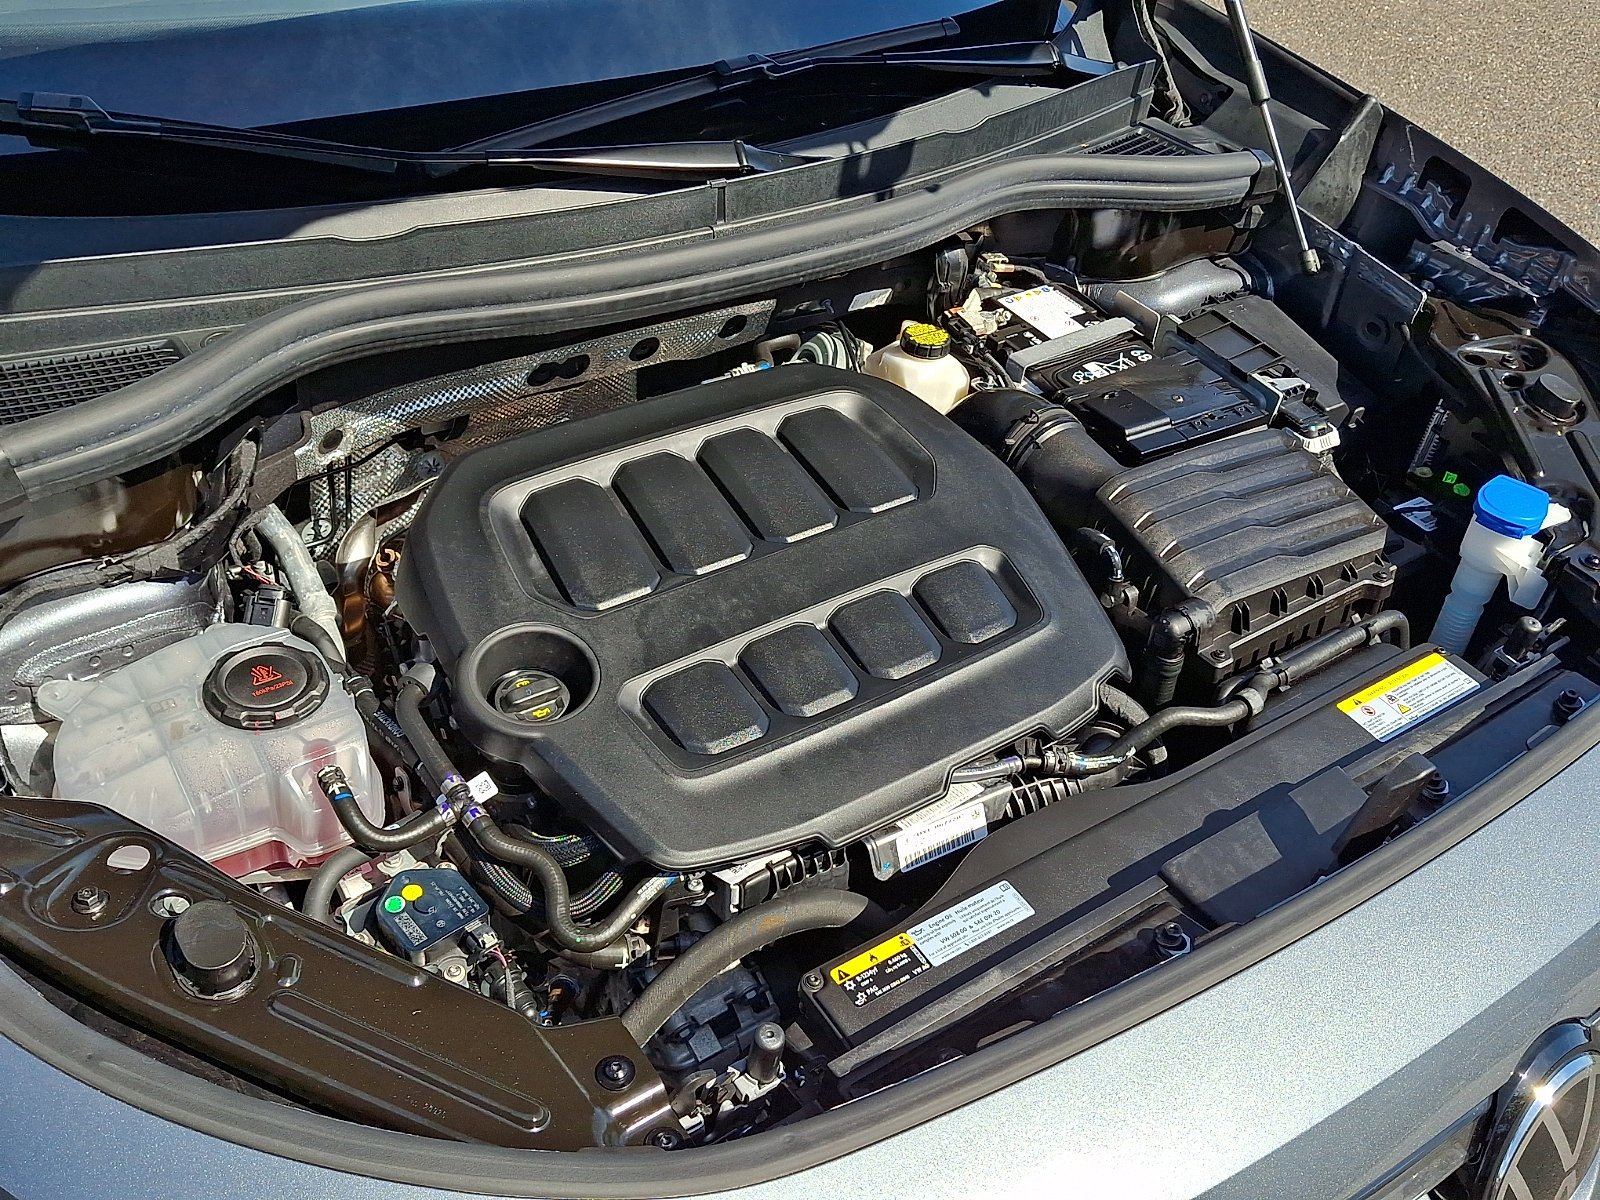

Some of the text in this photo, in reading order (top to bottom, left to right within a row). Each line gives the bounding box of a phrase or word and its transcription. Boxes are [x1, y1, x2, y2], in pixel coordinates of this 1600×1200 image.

[252, 680, 294, 697] 160kPa/23PSI
[953, 896, 985, 914] Huile moteur
[927, 917, 945, 929] Engine
[939, 935, 950, 943] VW
[973, 917, 985, 925] SAE
[912, 966, 923, 975] VW
[865, 984, 879, 995] PAG
